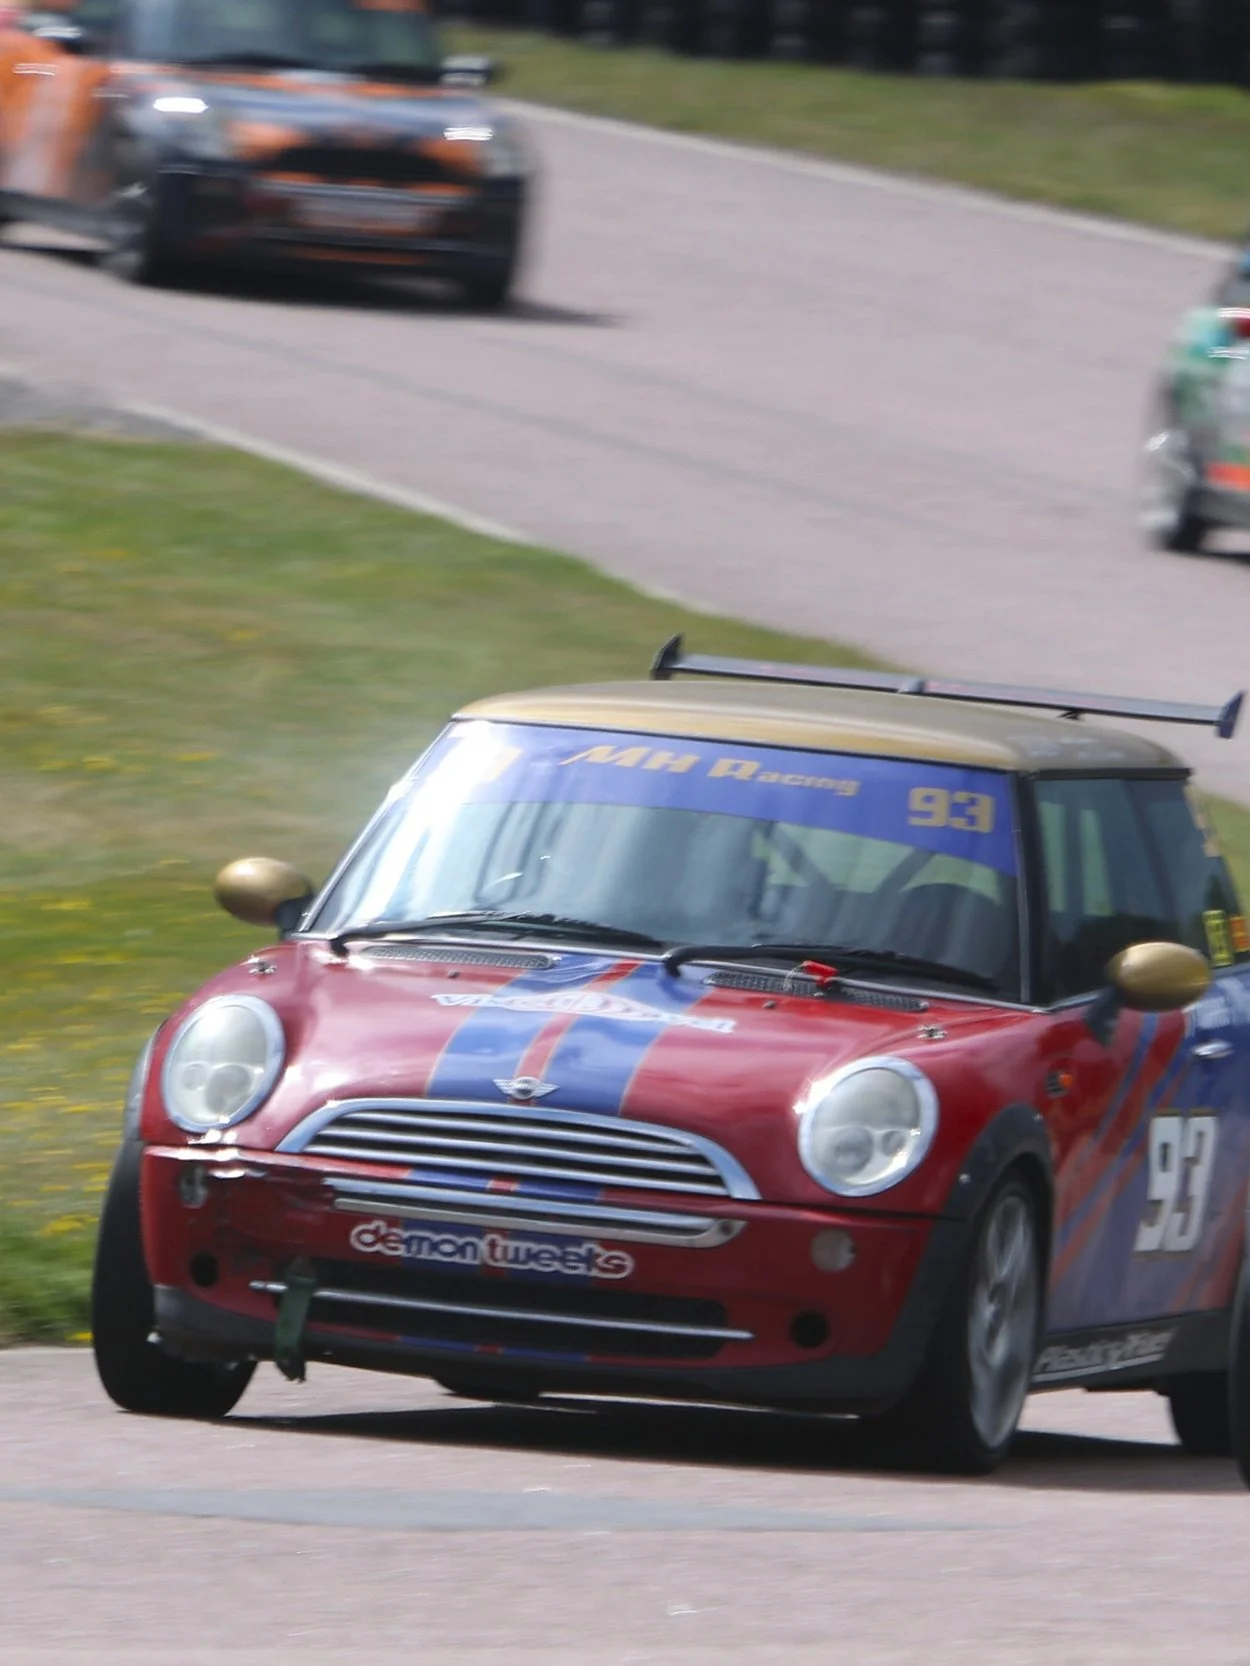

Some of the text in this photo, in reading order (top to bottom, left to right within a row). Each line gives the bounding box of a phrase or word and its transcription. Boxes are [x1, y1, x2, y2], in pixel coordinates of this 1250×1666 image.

[557, 744, 701, 774] MH
[706, 757, 863, 797] Racing
[907, 786, 996, 834] 93
[1133, 1112, 1220, 1254] 93
[350, 1219, 635, 1280] demon tweeks
